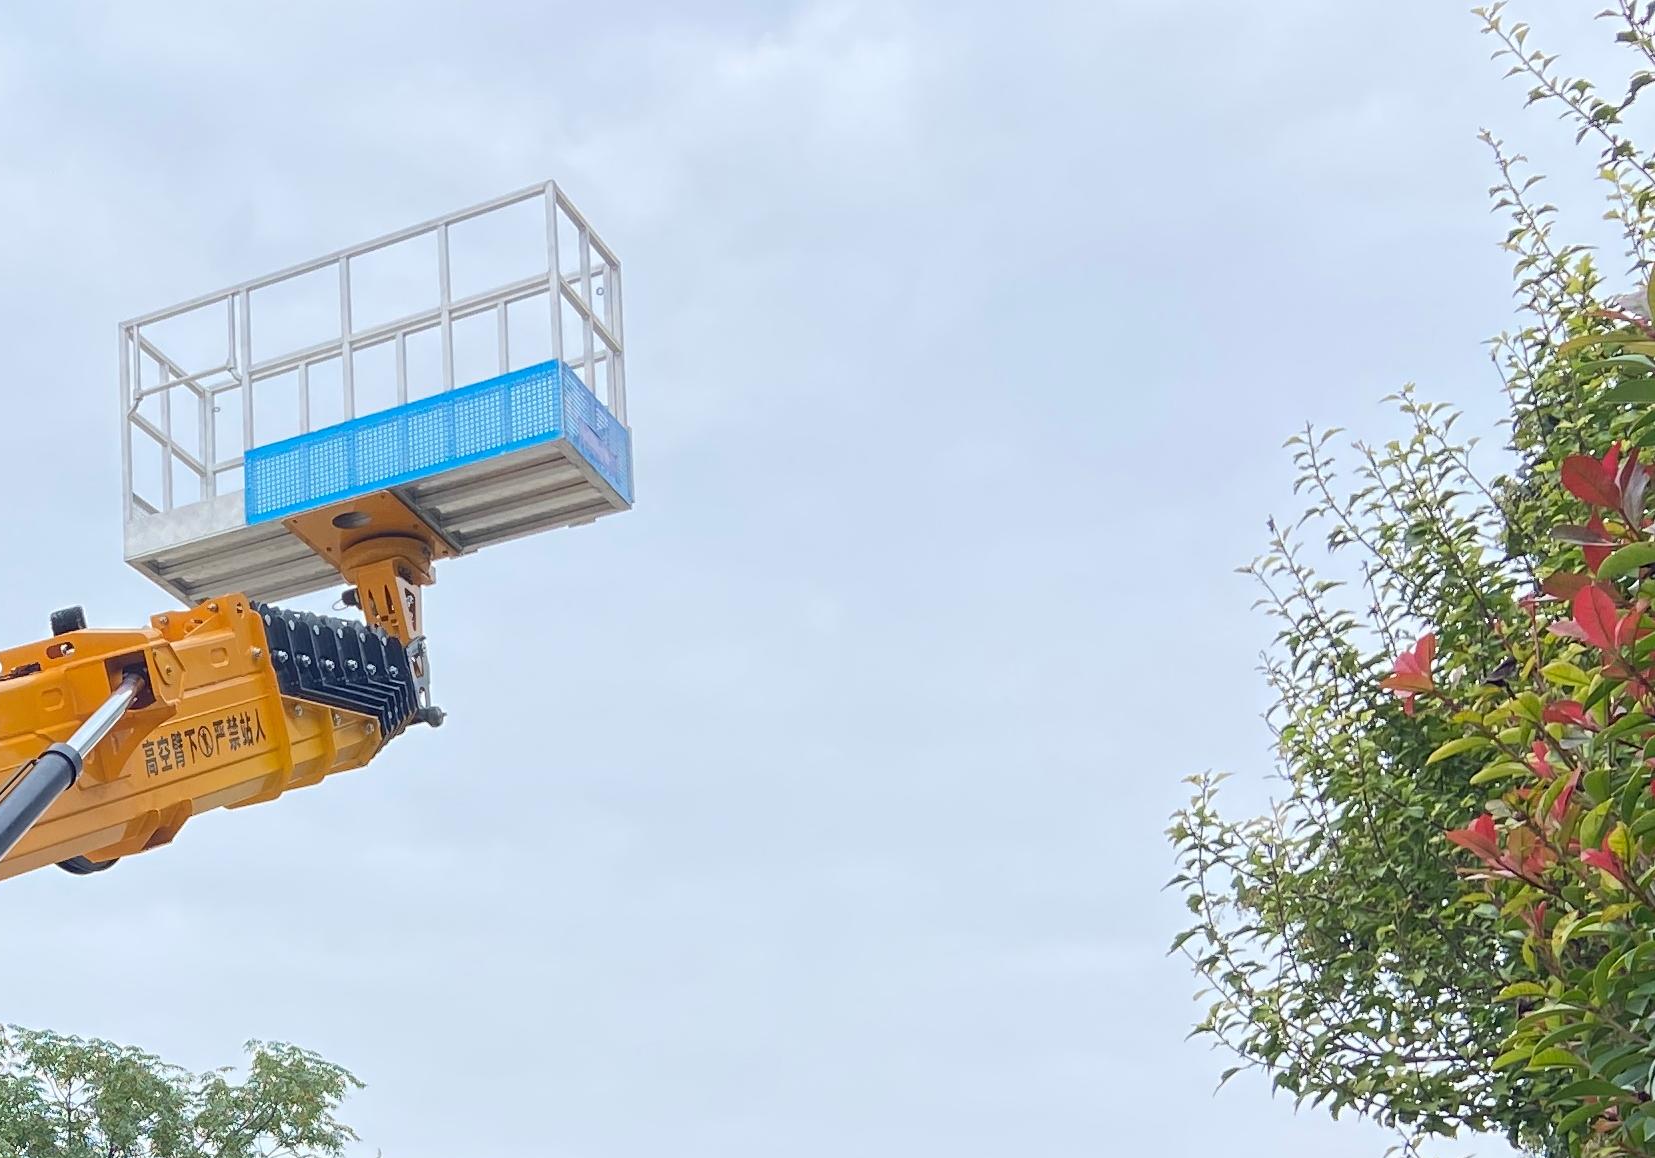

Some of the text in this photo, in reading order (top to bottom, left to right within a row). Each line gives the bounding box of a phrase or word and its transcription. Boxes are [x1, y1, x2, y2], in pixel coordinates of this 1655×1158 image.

[142, 709, 266, 778] 高空臂下 严禁站人
